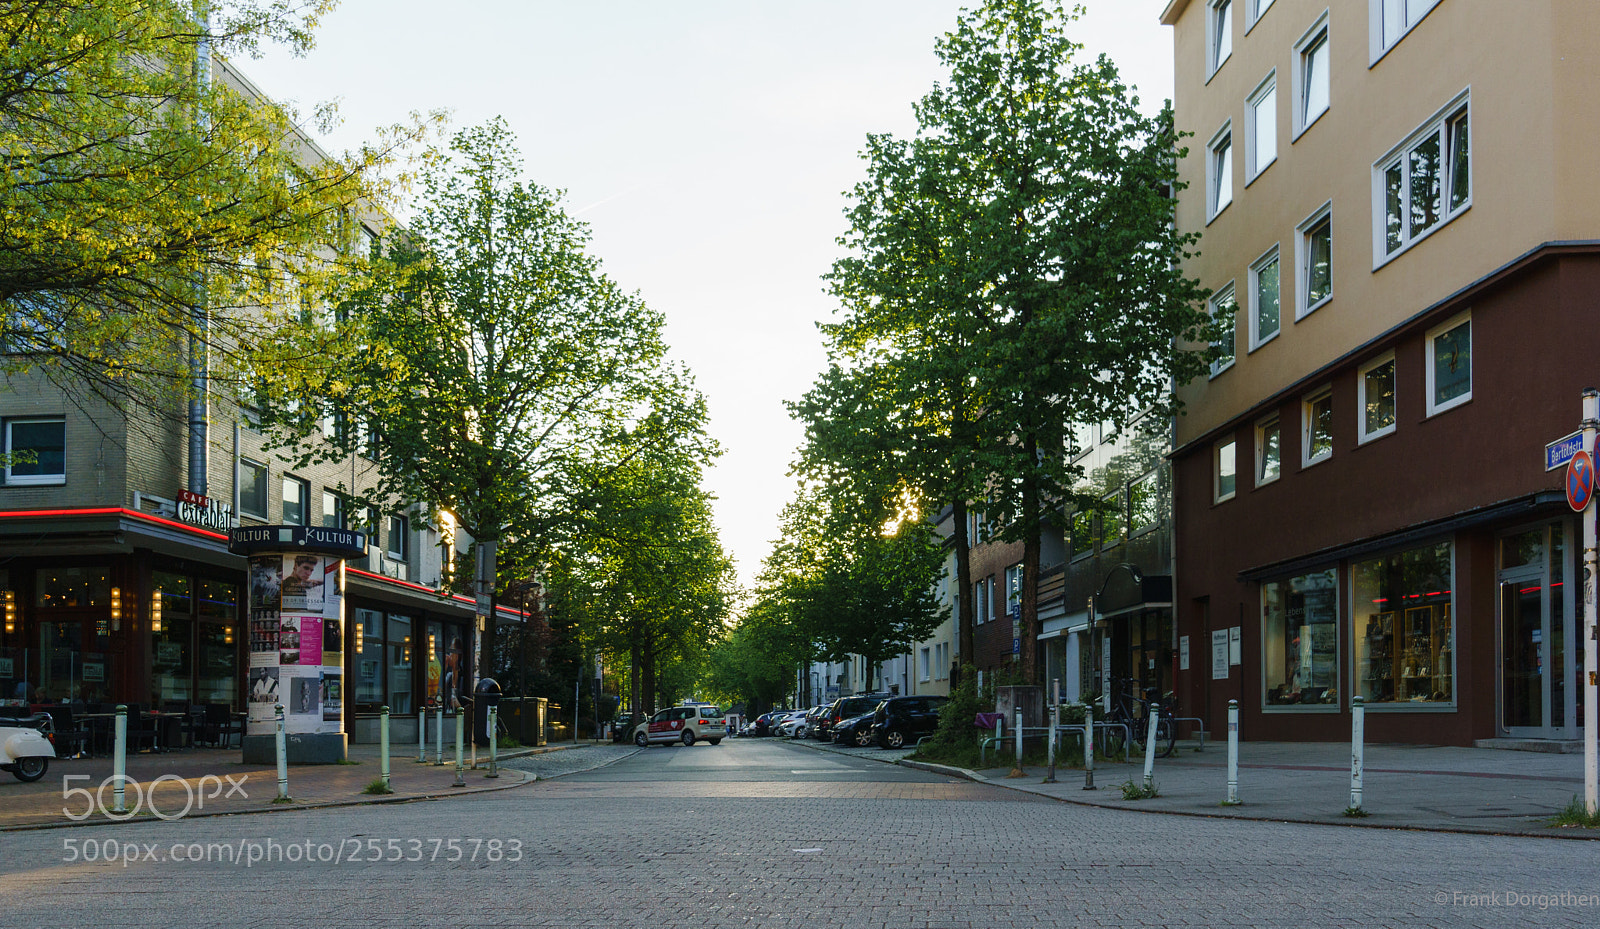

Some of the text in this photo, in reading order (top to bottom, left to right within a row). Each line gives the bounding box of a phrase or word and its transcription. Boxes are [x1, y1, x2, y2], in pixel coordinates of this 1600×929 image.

[183, 491, 209, 506] CAFE
[178, 498, 235, 532] extrablatt
[231, 529, 271, 543] KULTUR
[305, 527, 353, 545] KULTUR
